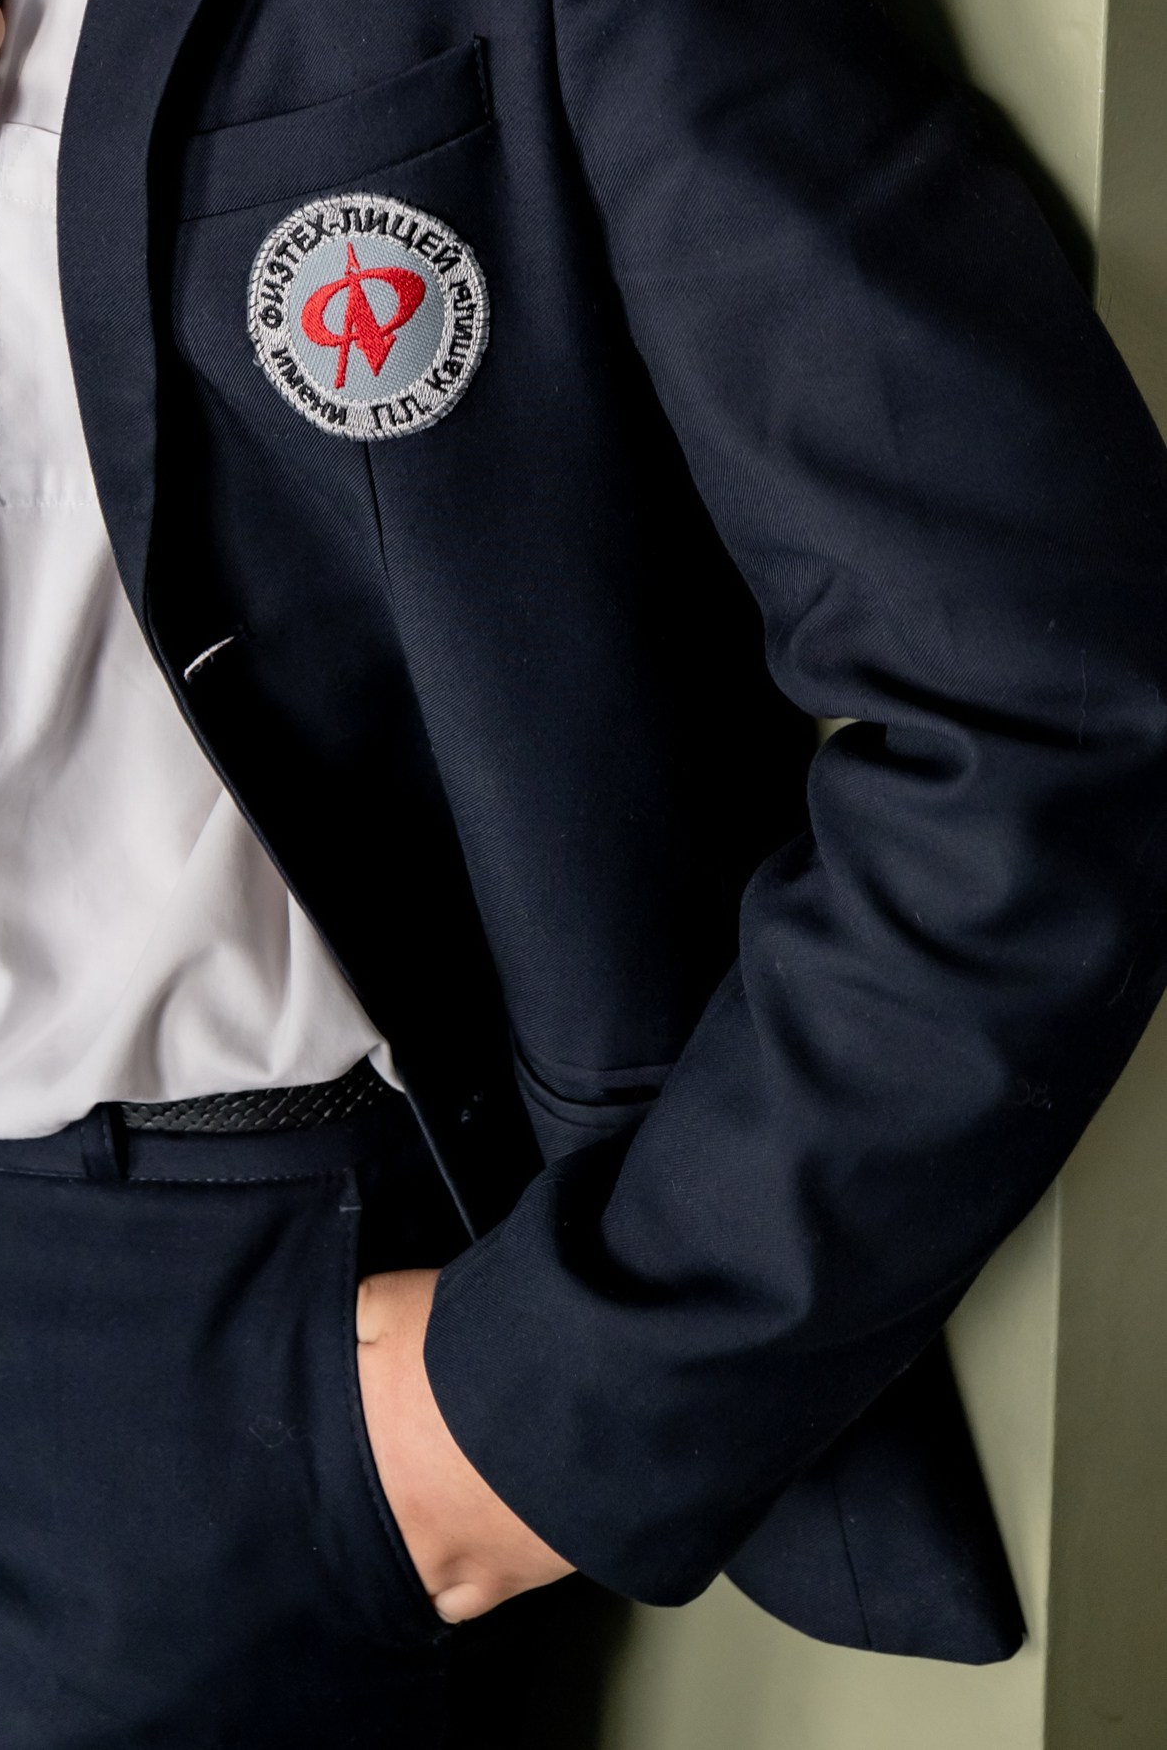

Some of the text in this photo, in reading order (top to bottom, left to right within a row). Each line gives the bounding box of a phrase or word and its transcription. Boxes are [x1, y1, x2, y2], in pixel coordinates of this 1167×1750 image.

[258, 207, 463, 329] ФИЗТЕХ-ЛИЦЕЙ
[271, 347, 347, 425] имени
[425, 280, 477, 392] Капицы
